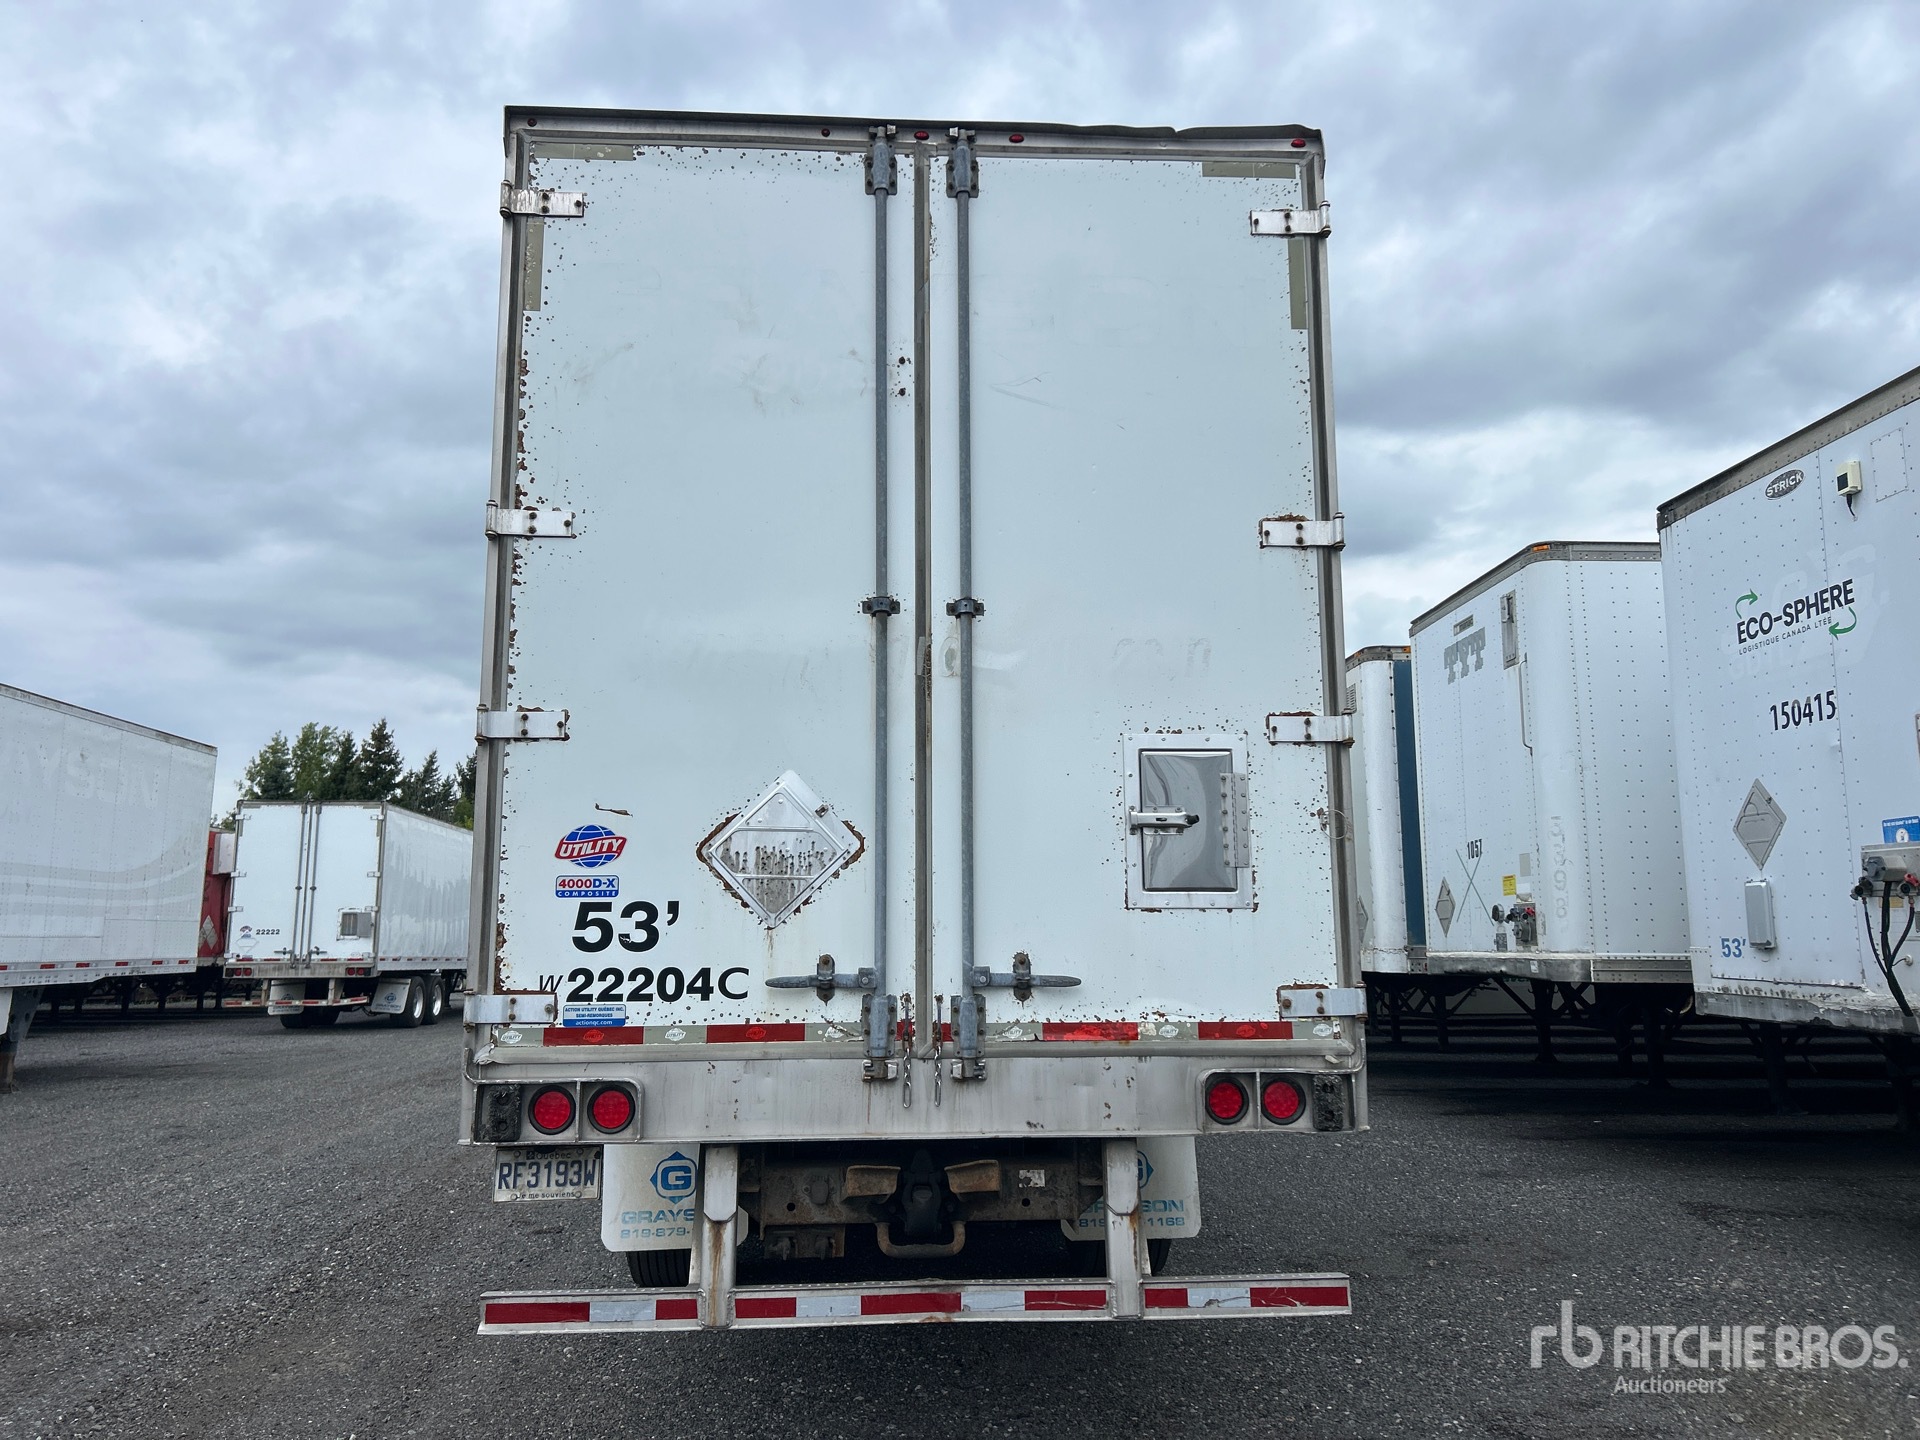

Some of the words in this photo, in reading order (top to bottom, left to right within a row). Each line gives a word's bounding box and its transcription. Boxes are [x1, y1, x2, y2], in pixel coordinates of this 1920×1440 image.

[1766, 471, 1803, 497] STRICK
[1736, 578, 1855, 645] ECO-SPHERE
[1738, 634, 1780, 656] LOGISTIQUE
[1781, 623, 1812, 641] CANADA
[1769, 689, 1837, 731] 150415
[559, 839, 623, 858] UTILITY
[558, 878, 616, 889] 4000D-X
[571, 900, 681, 953] 53'
[1720, 937, 1747, 959] 53'
[497, 1160, 596, 1190] RF3193W
[528, 1191, 539, 1199] me
